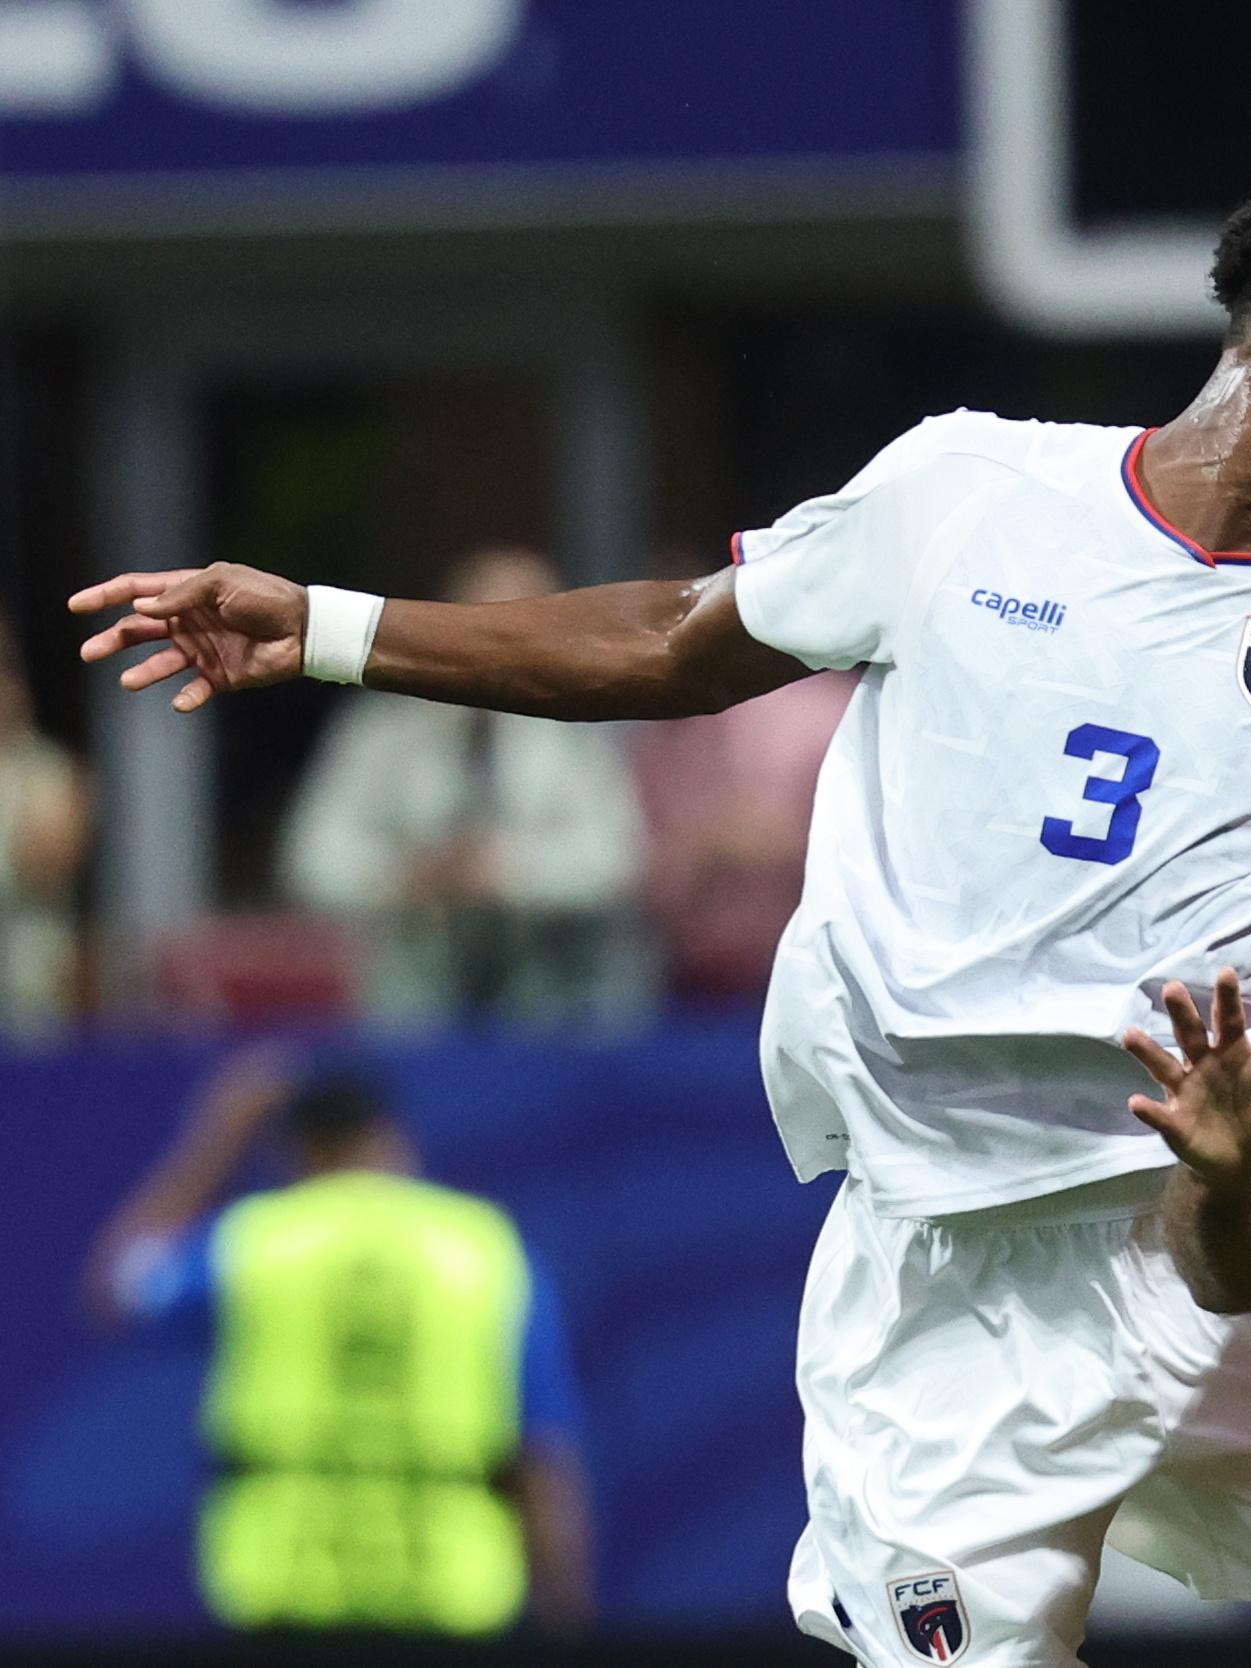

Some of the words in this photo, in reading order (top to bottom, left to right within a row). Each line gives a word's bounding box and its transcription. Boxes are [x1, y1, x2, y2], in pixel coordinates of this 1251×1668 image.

[971, 588, 1068, 626] capelli
[1007, 615, 1059, 635] SPORT
[1040, 722, 1161, 867] 3
[894, 1577, 950, 1602] FCF
